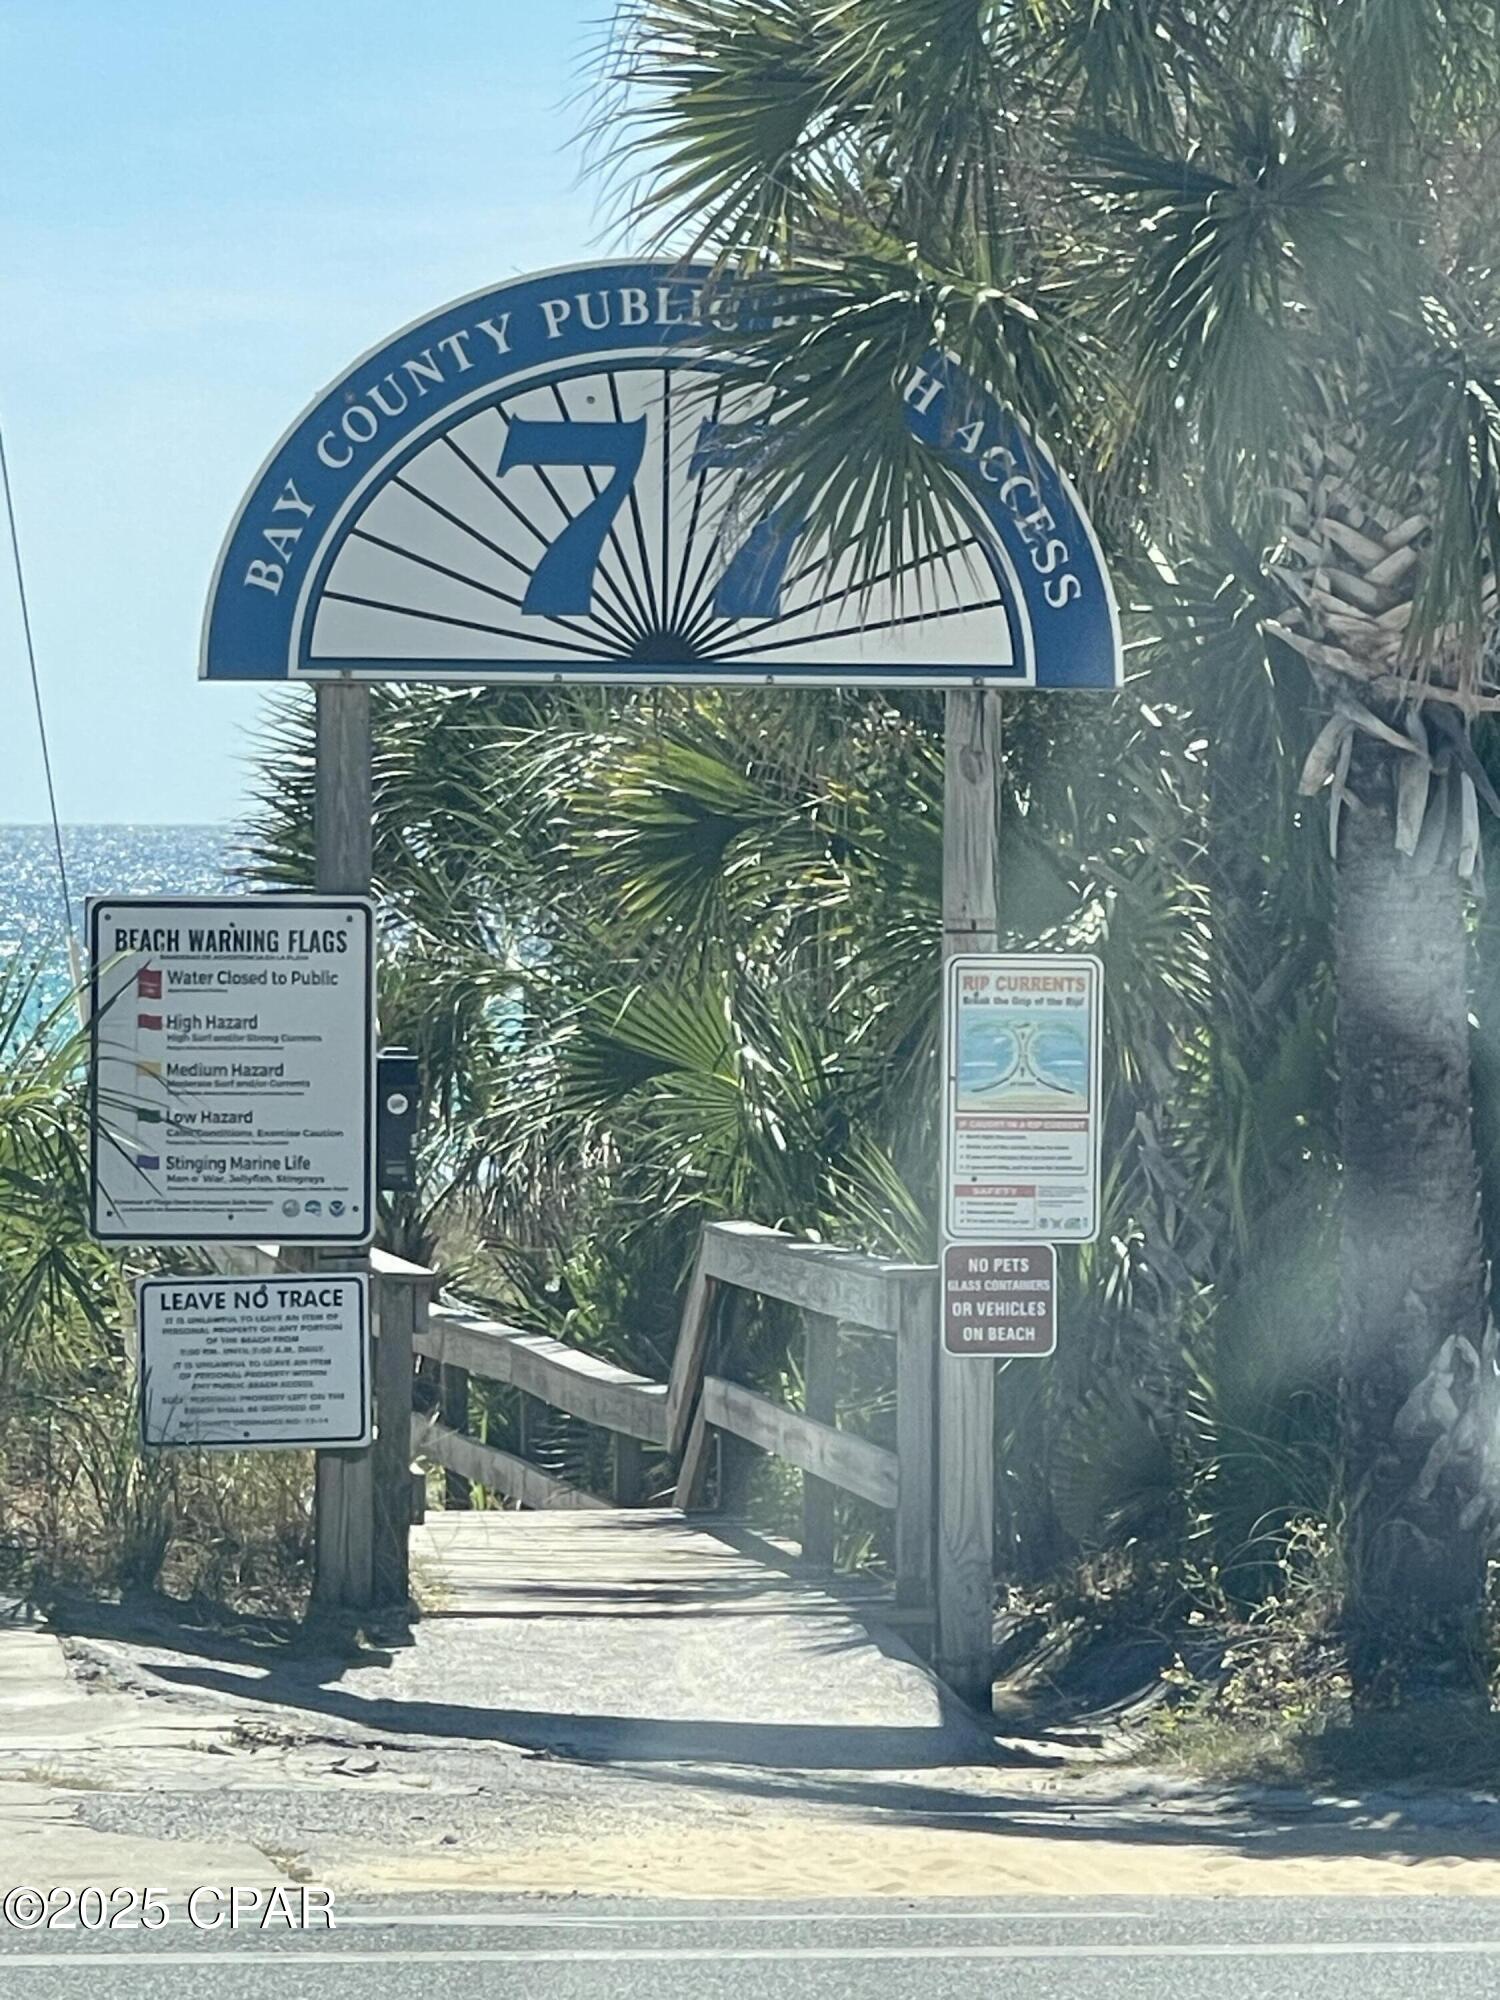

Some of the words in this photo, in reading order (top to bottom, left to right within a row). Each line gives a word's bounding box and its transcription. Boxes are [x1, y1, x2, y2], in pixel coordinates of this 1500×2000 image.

[244, 478, 317, 597] BAY
[317, 312, 515, 470] COUNTY
[540, 286, 743, 339] PUBLIC
[956, 419, 1082, 610] ACCESS
[496, 411, 832, 618] 77
[115, 928, 179, 953] BEACH
[189, 929, 279, 953] WARNING
[288, 929, 348, 953] FLAGS
[167, 970, 213, 985] Water
[217, 970, 267, 985] Closed
[272, 972, 287, 985] to
[291, 971, 338, 986] Public
[963, 976, 990, 991] RIP
[996, 976, 1086, 992] CURRENTS
[166, 1015, 202, 1031] High
[206, 1015, 258, 1029] Hazard
[167, 1064, 228, 1077] Medium
[232, 1064, 284, 1077] Hazard
[167, 1111, 196, 1124] Low
[201, 1111, 253, 1124] Hazard
[166, 1156, 226, 1172] Stinging
[230, 1156, 281, 1170] Marine
[285, 1156, 311, 1170] Life
[968, 1258, 989, 1272] NO
[994, 1258, 1030, 1272] PETS
[947, 1280, 981, 1291] GLASS
[984, 1280, 1050, 1291] CONTAINERS
[160, 1291, 226, 1311] LEAVE
[234, 1291, 269, 1309] NO
[277, 1289, 343, 1308] TRACE
[952, 1301, 972, 1316] OR
[976, 1301, 1046, 1316] VEHICLES
[963, 1327, 983, 1341] ON
[988, 1327, 1036, 1341] BEACH
